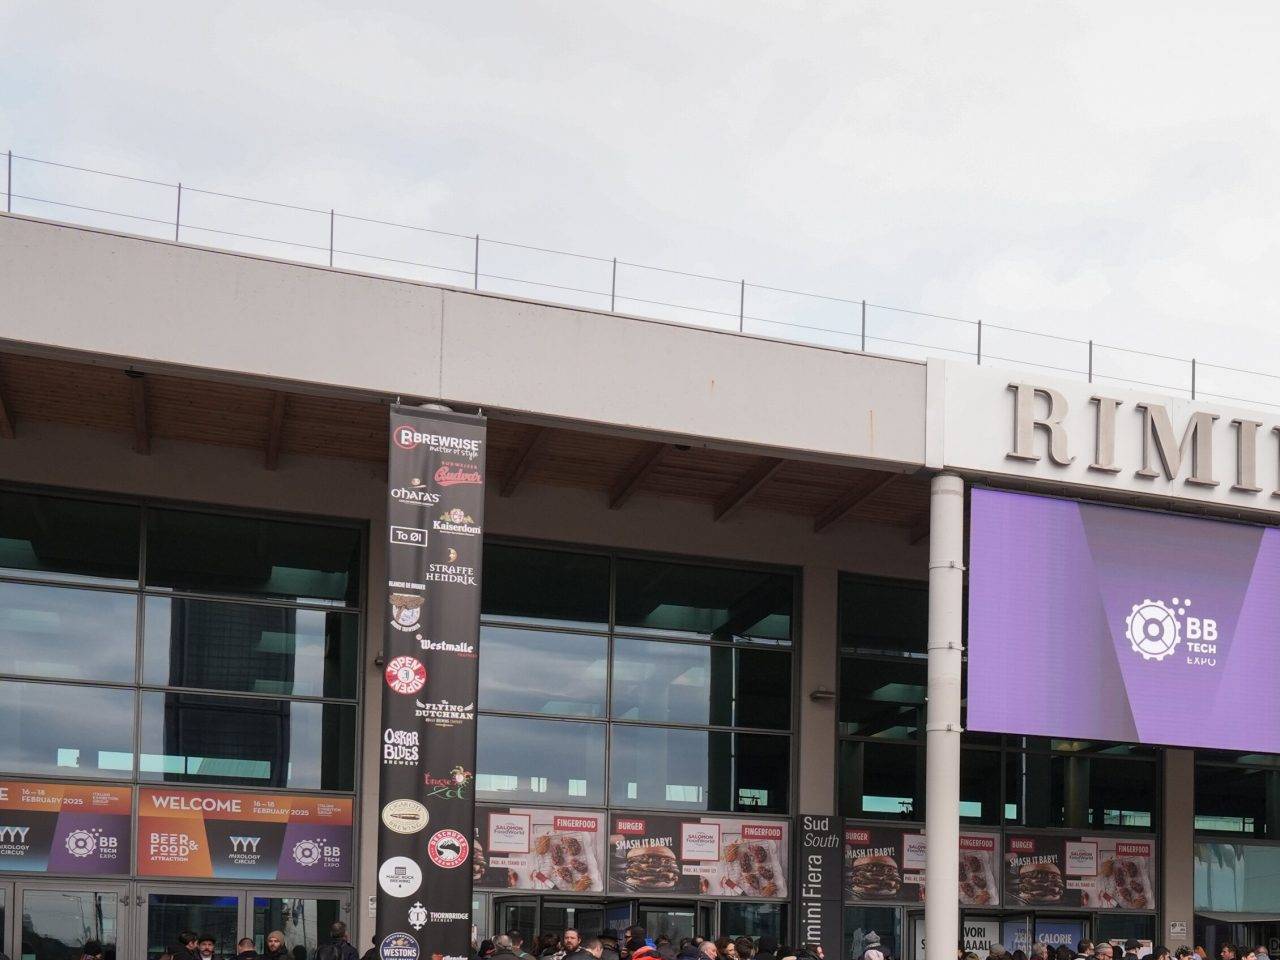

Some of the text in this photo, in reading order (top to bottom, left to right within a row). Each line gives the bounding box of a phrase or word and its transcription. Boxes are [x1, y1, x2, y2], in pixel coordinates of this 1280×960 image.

[413, 433, 479, 451] BREWRISE
[433, 520, 481, 534] Kaiserdom
[396, 530, 408, 540] To
[429, 563, 474, 575] STRAFFE
[425, 573, 477, 586] HENDRIK
[1186, 617, 1218, 641] BB
[420, 639, 473, 653] Westmalle
[1187, 642, 1217, 654] TECH
[386, 656, 422, 675] JOPEN
[425, 703, 464, 712] FLYING
[415, 710, 474, 720] DUTCHMAN
[384, 728, 419, 746] OSKAR
[384, 744, 419, 761] BLUES
[22, 796, 61, 804] FEBRUARY
[152, 795, 242, 812] WELCOME
[253, 807, 290, 815] FEBRUARY
[557, 819, 596, 828] FINGERFOOD
[618, 822, 643, 831] BURGER
[803, 816, 829, 831] Sud
[744, 828, 781, 837] FINGERFOOD
[845, 831, 868, 841] BURGER
[100, 837, 118, 847] BB
[150, 833, 199, 850] BEER &
[430, 831, 466, 847] DESCHUTES
[616, 837, 673, 850] SMASH IT BABY!
[803, 833, 839, 848] South
[960, 839, 993, 848] FINGERFOOD
[1012, 840, 1033, 849] BURGER
[150, 845, 189, 856] FOOD
[323, 846, 341, 856] BB
[867, 848, 874, 857] IT
[874, 847, 895, 856] BABY!
[1118, 845, 1149, 853] FINGERFOOD
[1010, 854, 1058, 867] SMASH IT BABY!
[802, 854, 822, 945] imini Fiera
[430, 912, 469, 920] THORNBRIDGE
[964, 926, 986, 938] VORI
[1038, 933, 1073, 944] CALORIE
[383, 948, 417, 957] WESTONS
